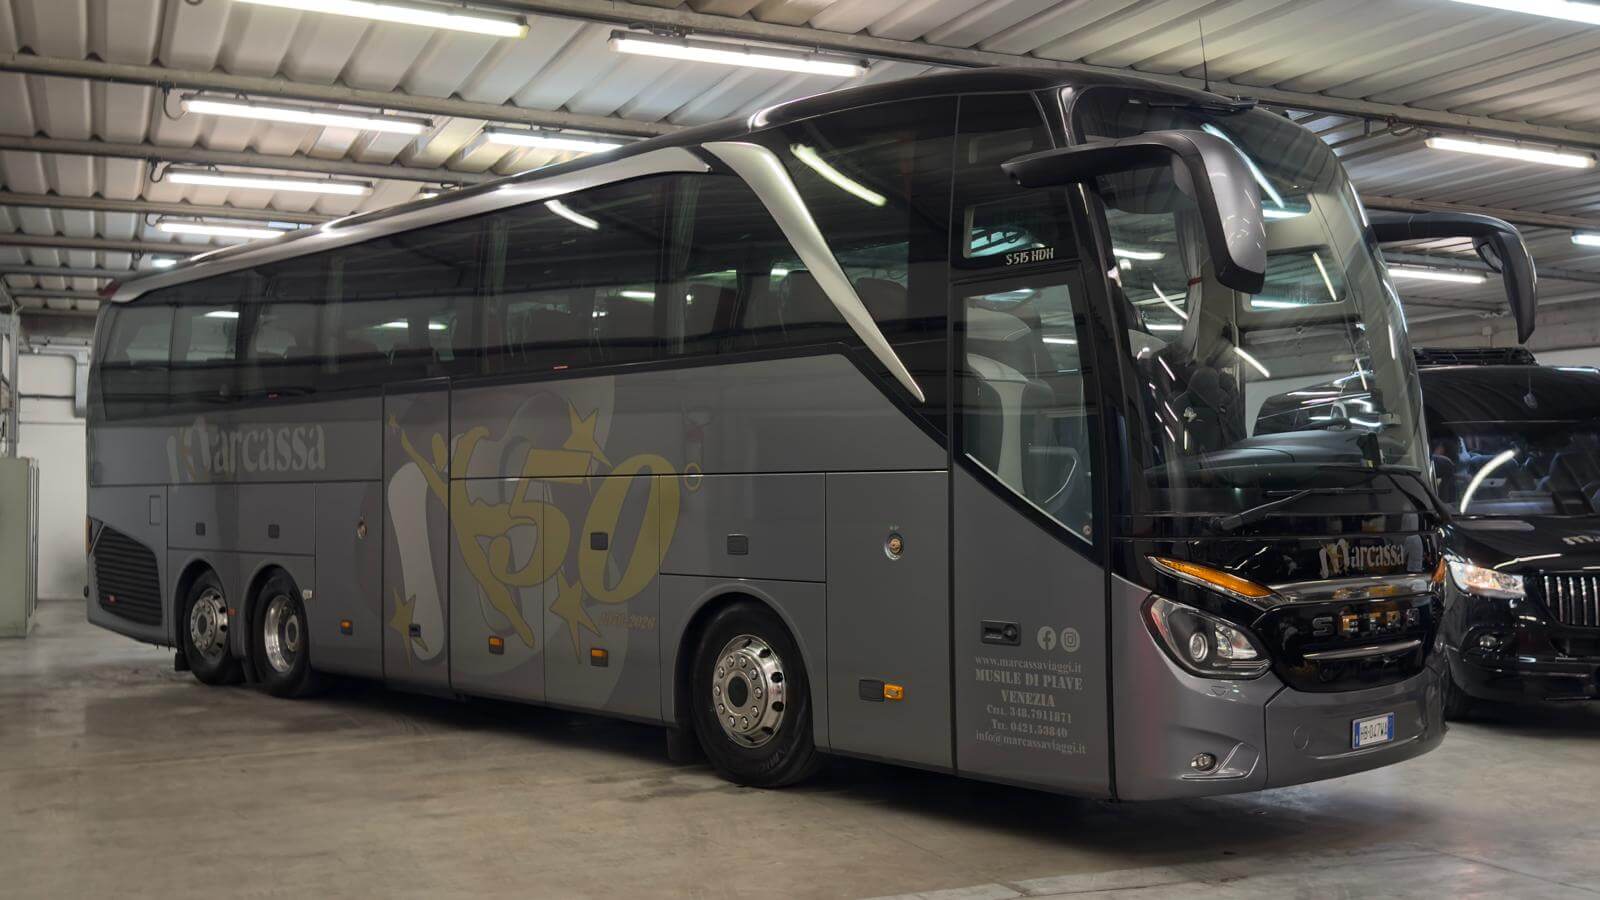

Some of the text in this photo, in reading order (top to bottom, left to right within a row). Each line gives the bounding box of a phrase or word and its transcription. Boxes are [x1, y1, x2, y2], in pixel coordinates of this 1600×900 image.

[1031, 247, 1054, 263] HDH
[166, 415, 327, 495] Marcassa
[1319, 538, 1404, 579] Marcassa
[975, 656, 1081, 674] www.marcassaviaggi.it
[975, 669, 1083, 691] MUSILE DI PIAVE
[1001, 689, 1056, 708] VENEZIA
[1010, 706, 1072, 724] 348.7911871
[975, 730, 1086, 755] info@marcassaviaggi.it
